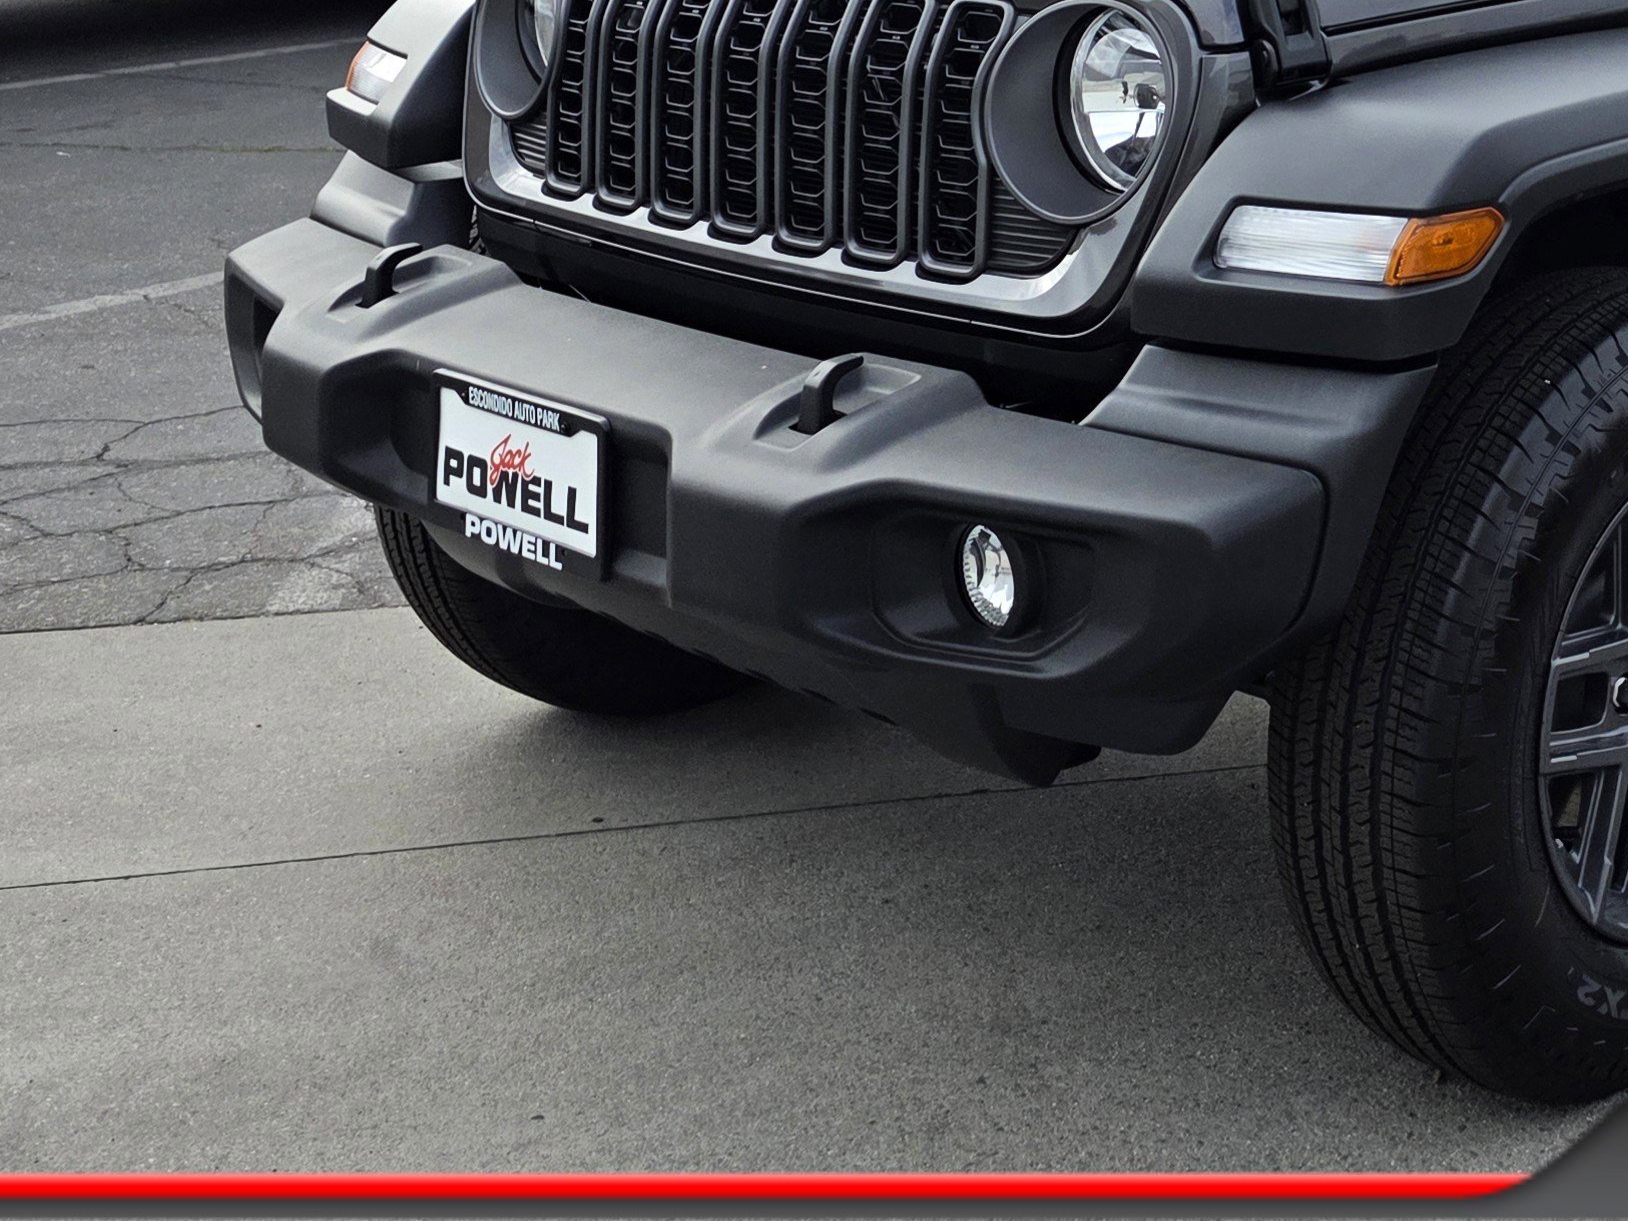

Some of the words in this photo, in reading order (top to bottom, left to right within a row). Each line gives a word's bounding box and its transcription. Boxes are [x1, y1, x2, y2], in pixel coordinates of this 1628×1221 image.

[468, 386, 513, 417] ESCONDIDO
[513, 399, 536, 424] AUTO
[537, 407, 561, 432] PARK
[490, 434, 535, 486] Jack
[443, 445, 589, 535] POWELL
[465, 512, 563, 571] POWELL
